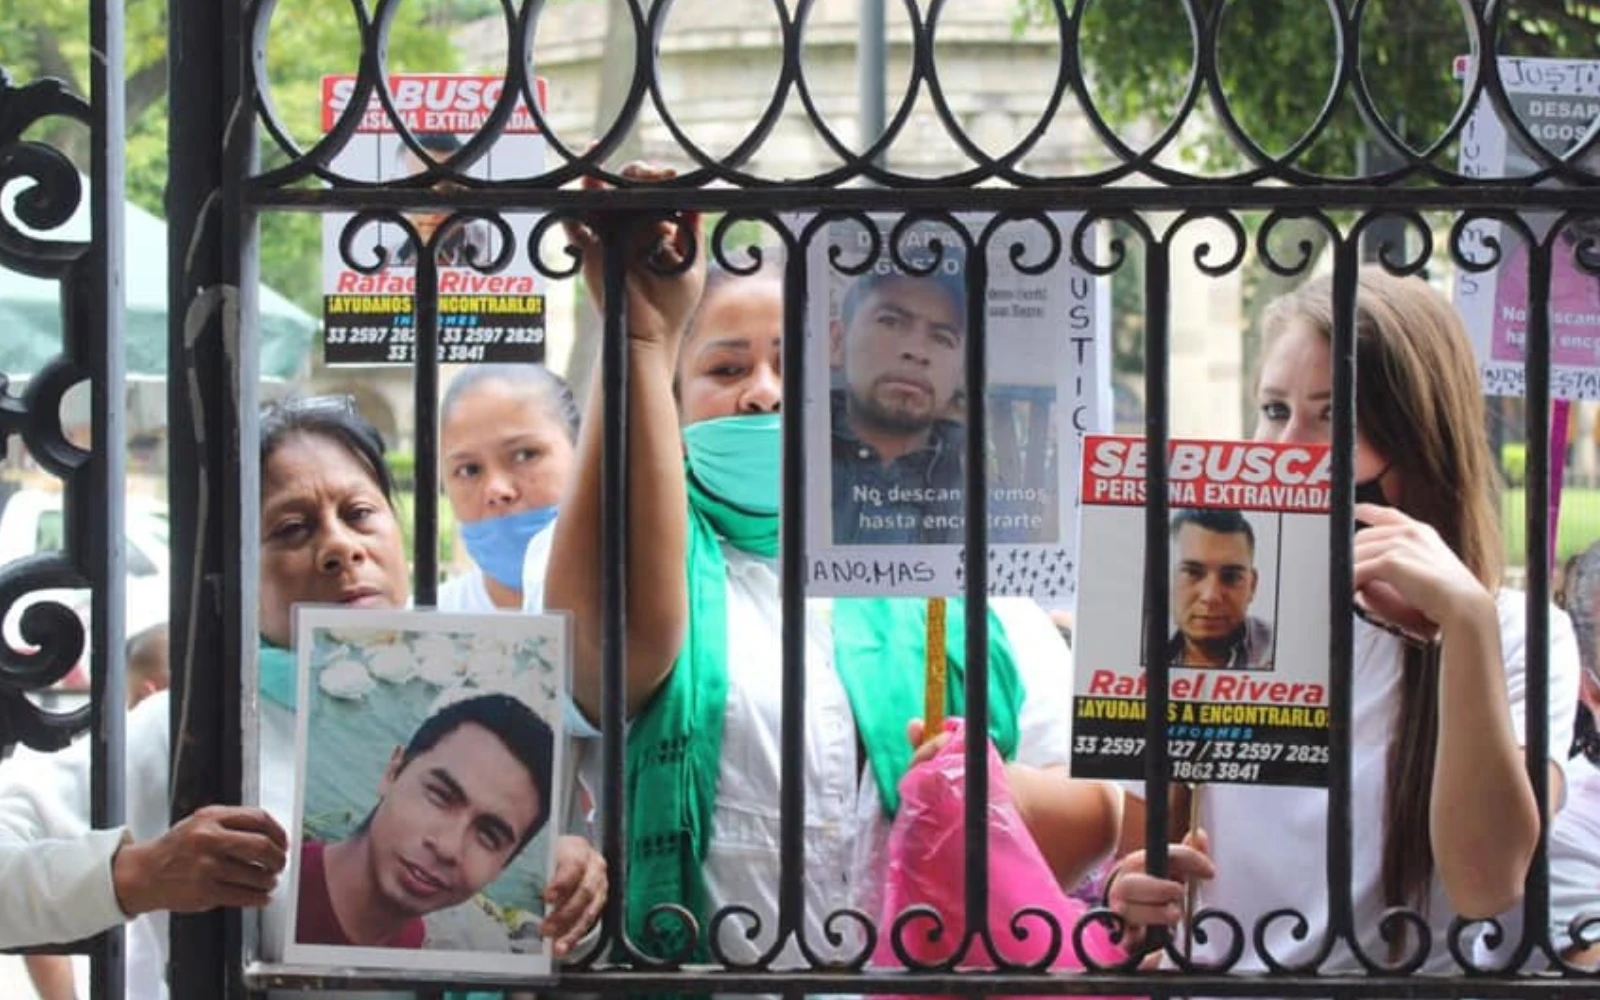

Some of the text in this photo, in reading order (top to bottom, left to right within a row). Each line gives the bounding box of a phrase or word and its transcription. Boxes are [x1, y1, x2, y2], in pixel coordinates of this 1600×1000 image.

[439, 271, 534, 294] Rivera
[326, 327, 347, 343] 33
[348, 327, 388, 343] 2597
[442, 327, 462, 343] 33
[463, 327, 504, 343] 2597
[386, 345, 408, 360] 33
[447, 345, 485, 360] 3841
[1094, 479, 1197, 503] PERSNA
[859, 512, 916, 530] hasta
[1211, 674, 1325, 705] Rivera
[1182, 704, 1195, 720] A
[1073, 736, 1098, 753] 33
[1100, 737, 1146, 757] 2597
[1211, 742, 1235, 760] 33
[1236, 743, 1284, 763] 2597
[1172, 761, 1261, 781] 1862 3841
